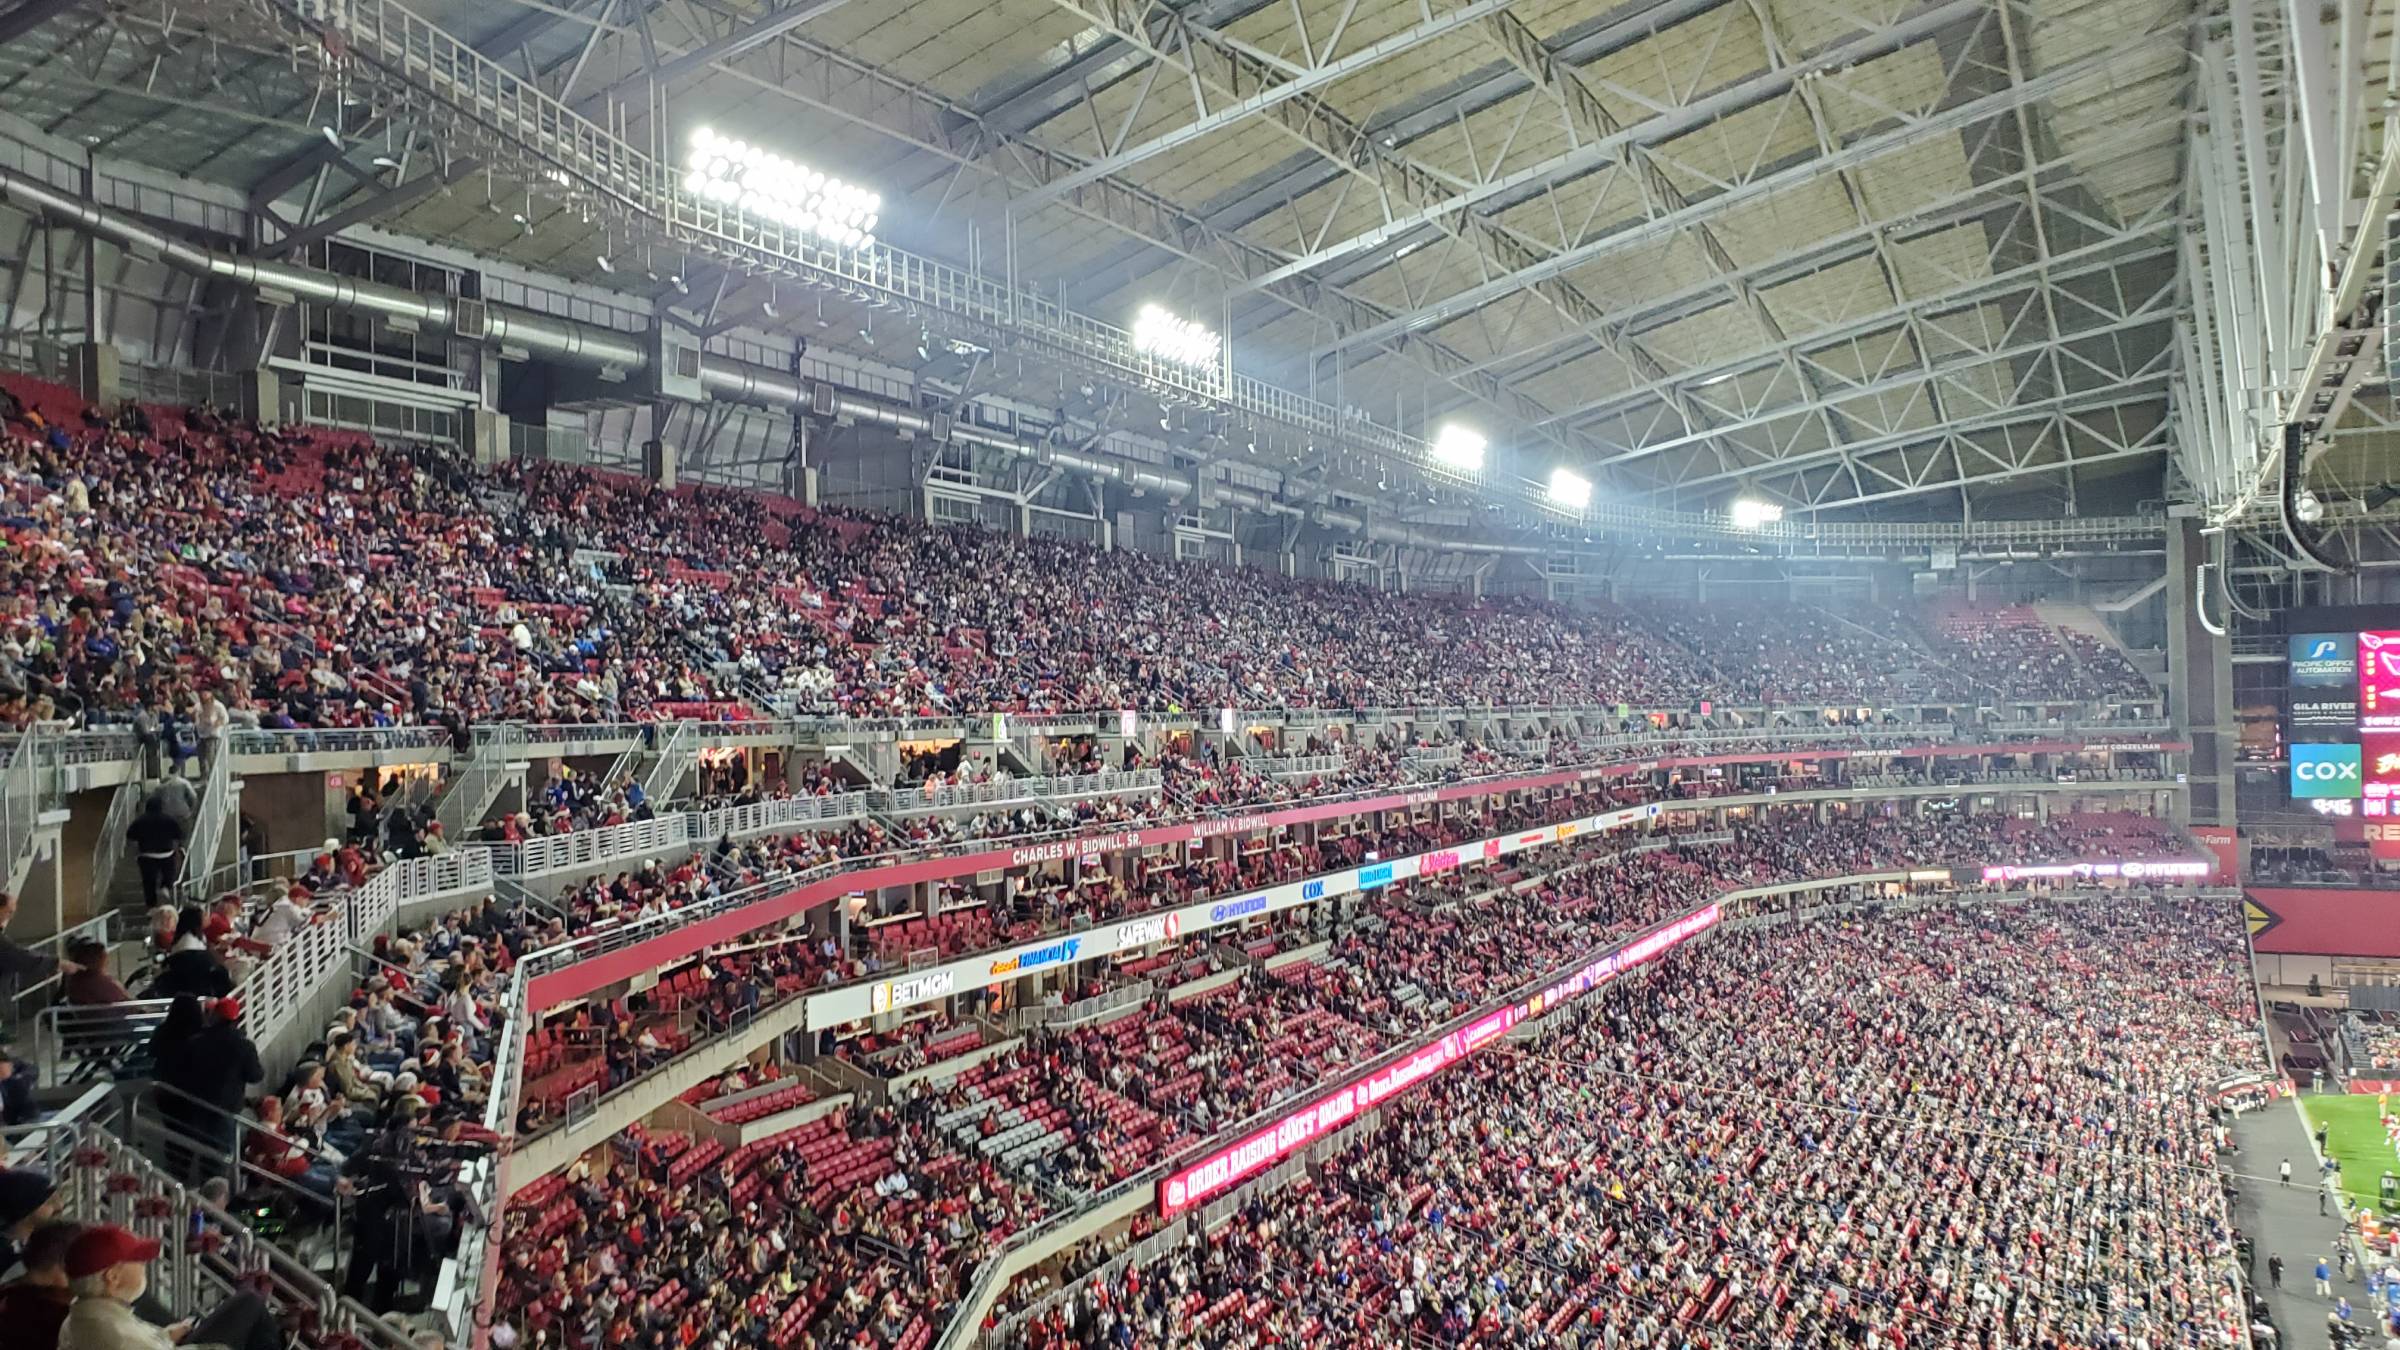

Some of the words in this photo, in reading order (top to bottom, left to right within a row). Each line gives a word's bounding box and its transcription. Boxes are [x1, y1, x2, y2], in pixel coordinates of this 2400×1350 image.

[2321, 702, 2356, 710] RIVER
[2296, 762, 2357, 780] COX
[1193, 820, 1228, 837] WILLIAM
[1230, 820, 1238, 831] V.
[1238, 816, 1269, 830] BIDWILL
[1013, 842, 1063, 866] CHARLES
[1066, 841, 1080, 857] W.
[1082, 834, 1125, 853] BIDWILL,
[1127, 834, 1142, 847] SR.
[1303, 880, 1324, 900] COX
[1118, 915, 1166, 947] SAFEWAY
[1018, 944, 1062, 969] FINANCIAL
[893, 971, 954, 1005] BETMGM
[1187, 1157, 1228, 1199] ORDER
[1230, 1131, 1277, 1177] RAISING
[1319, 1090, 1354, 1131] ONLINE
